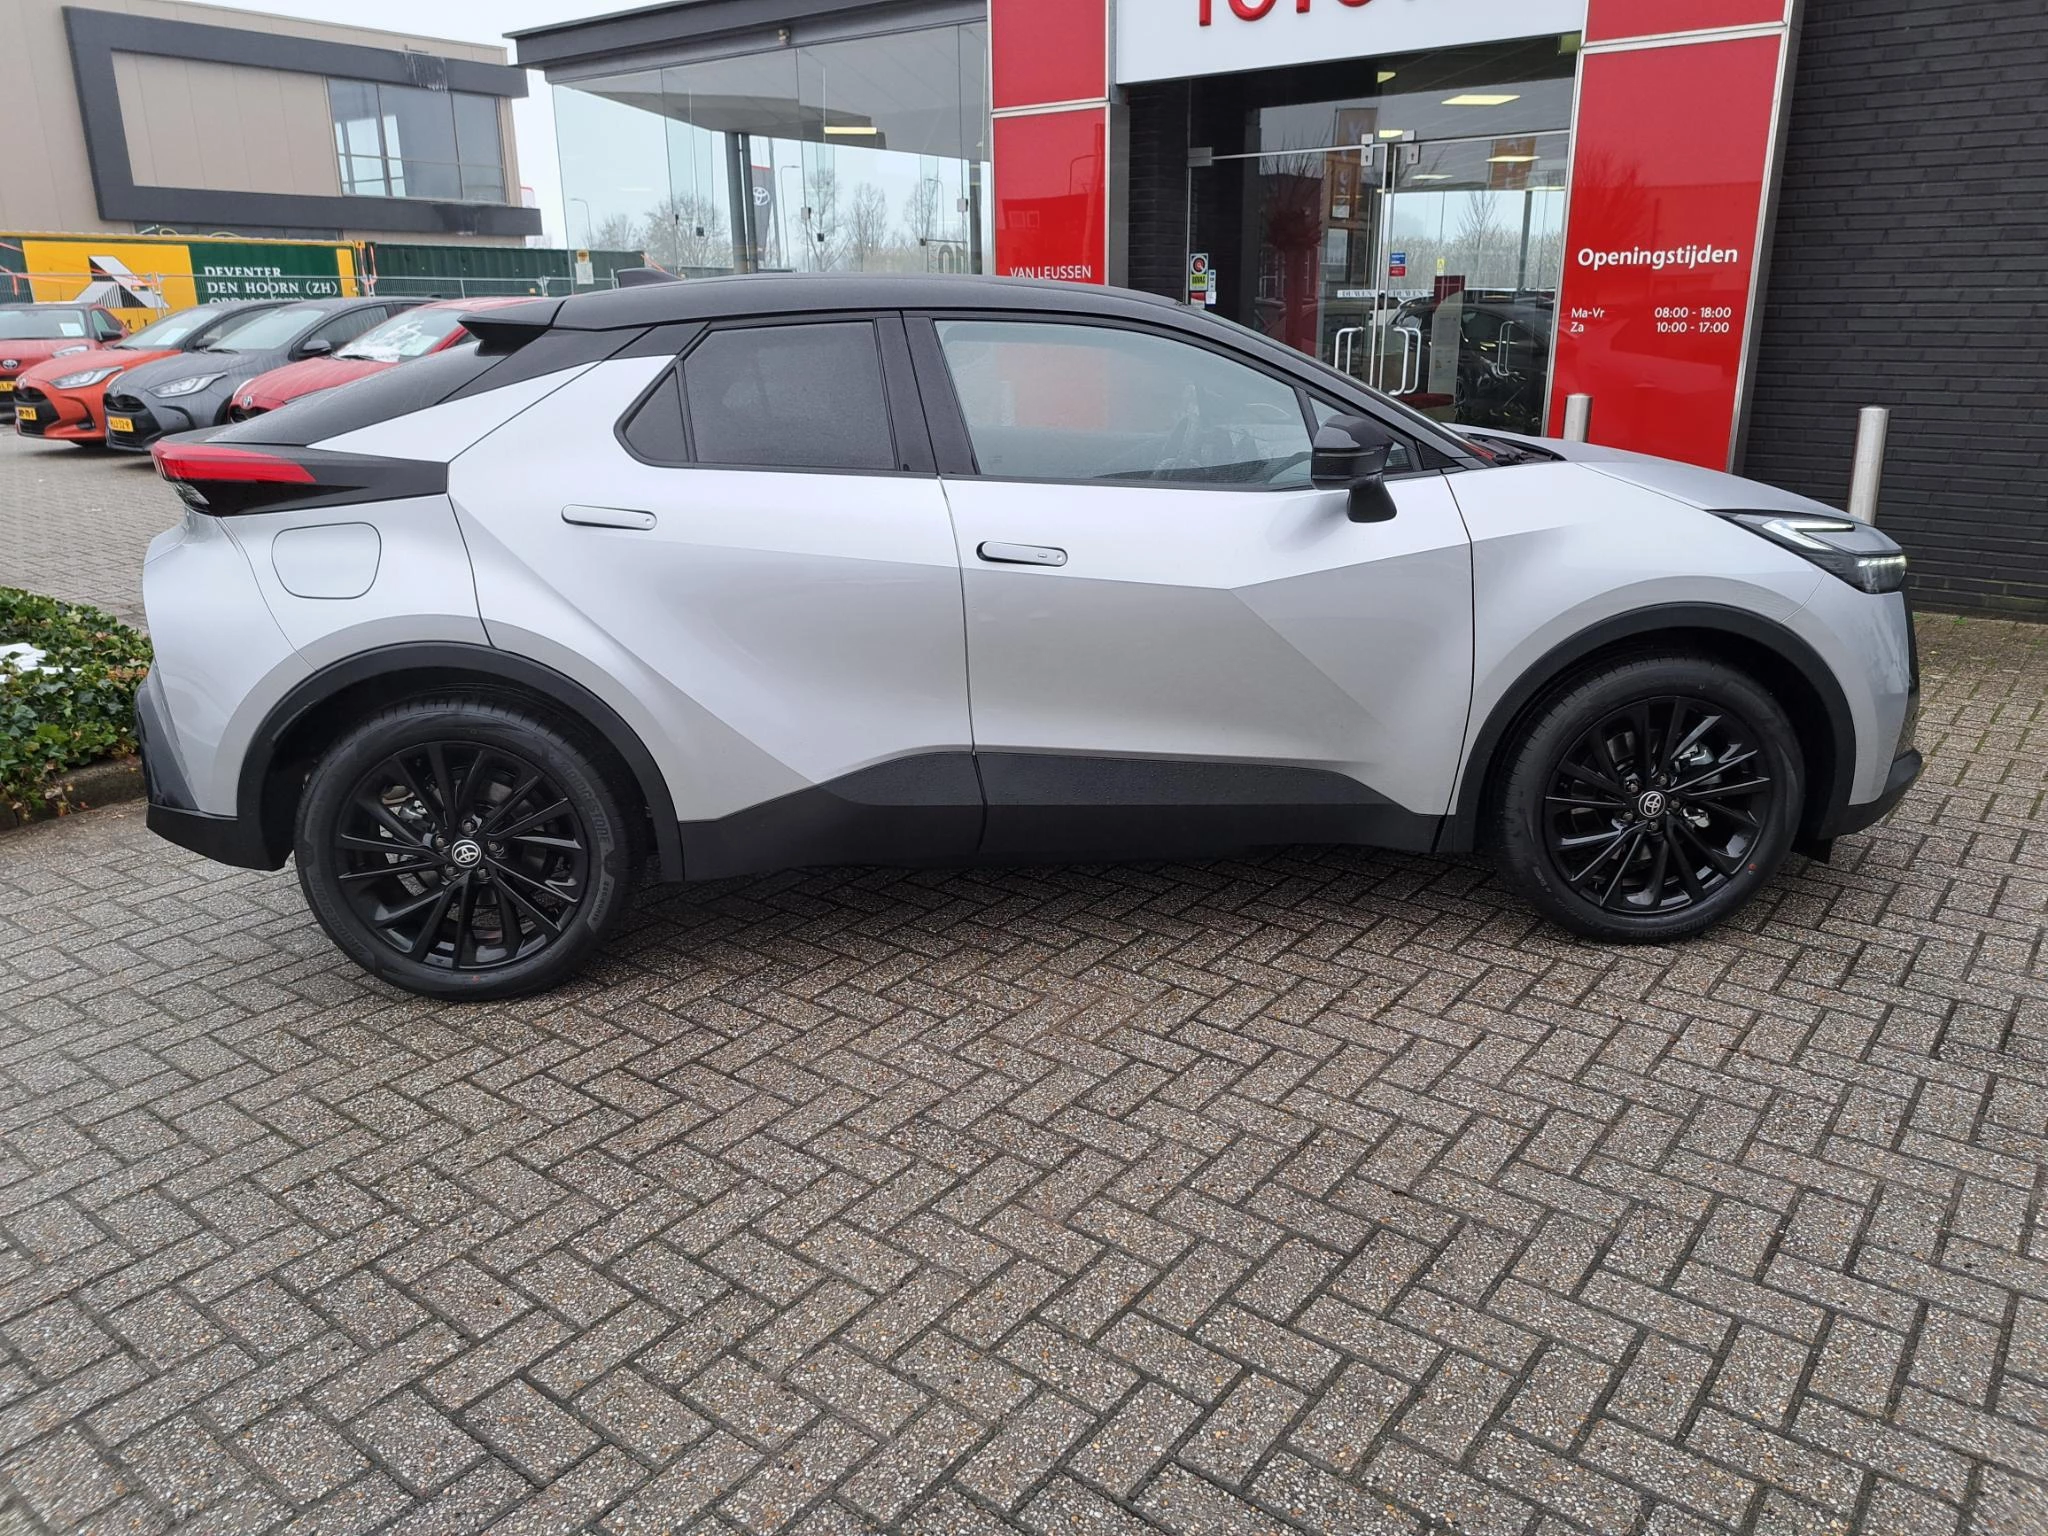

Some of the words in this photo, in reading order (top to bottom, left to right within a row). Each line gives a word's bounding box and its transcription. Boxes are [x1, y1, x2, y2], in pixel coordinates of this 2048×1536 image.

[1577, 244, 1738, 271] Openingstijden
[204, 266, 281, 277] DEVENTER
[1009, 266, 1035, 278] VAN
[1038, 265, 1092, 279] LEUSSEN
[206, 281, 238, 294] DEN
[245, 281, 299, 294] HOORN
[305, 281, 338, 296] (ZH)
[1571, 307, 1606, 319] Ma-Vr
[1654, 307, 1689, 319] 08:00
[1700, 307, 1732, 319] 18:00
[1570, 322, 1585, 333] Za
[1656, 321, 1688, 333] 10:00
[1698, 321, 1730, 333] 17:00
